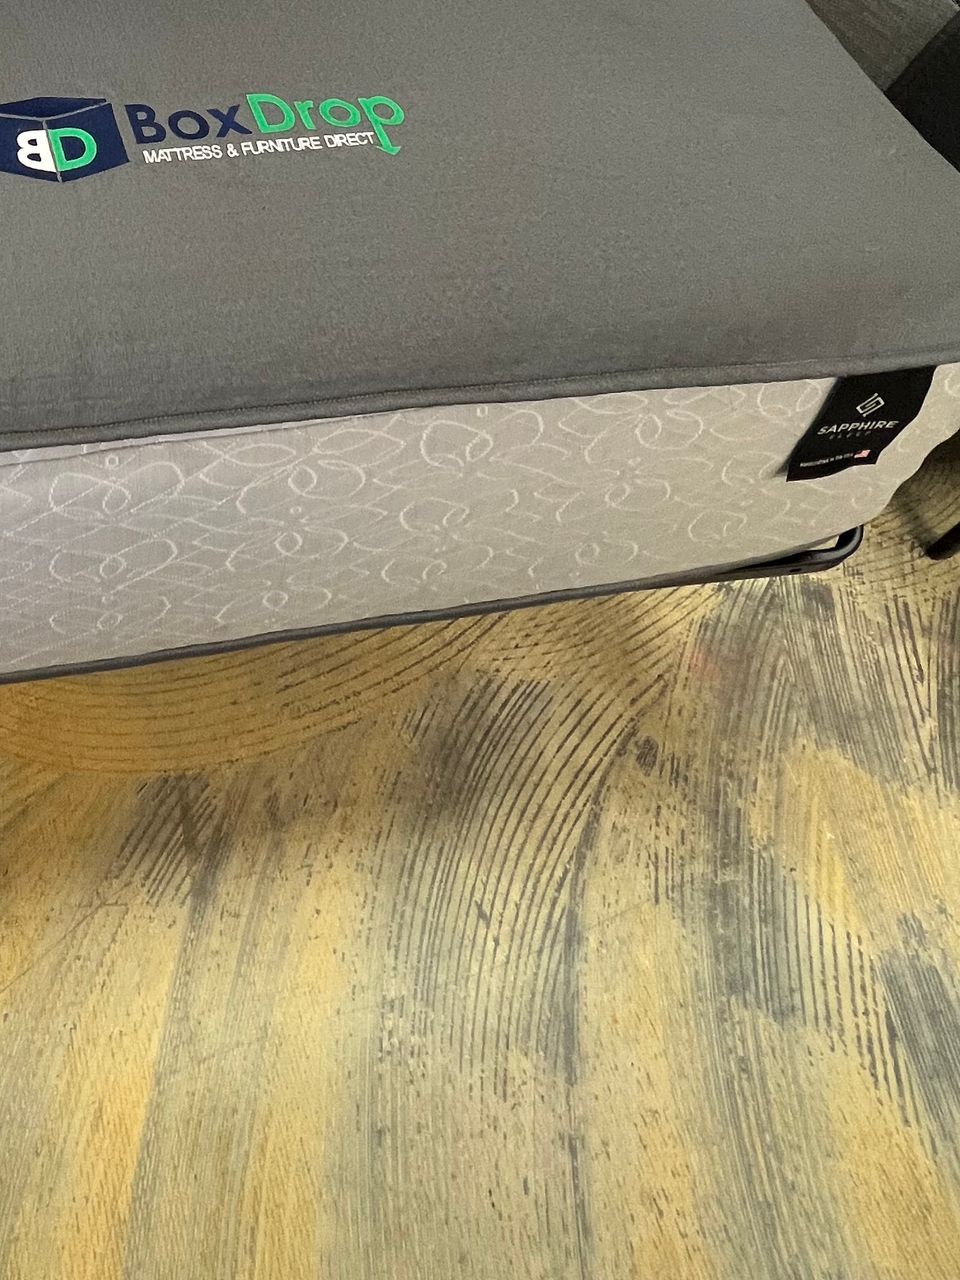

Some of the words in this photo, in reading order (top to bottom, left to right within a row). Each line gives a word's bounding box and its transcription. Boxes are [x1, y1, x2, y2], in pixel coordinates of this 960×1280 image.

[124, 91, 406, 157] BoxDrop
[142, 144, 224, 164] MATTRESS
[226, 143, 240, 158] &
[240, 135, 323, 157] FURNITURE
[323, 131, 375, 149] DIRECT
[817, 420, 900, 436] SAPPHIRE
